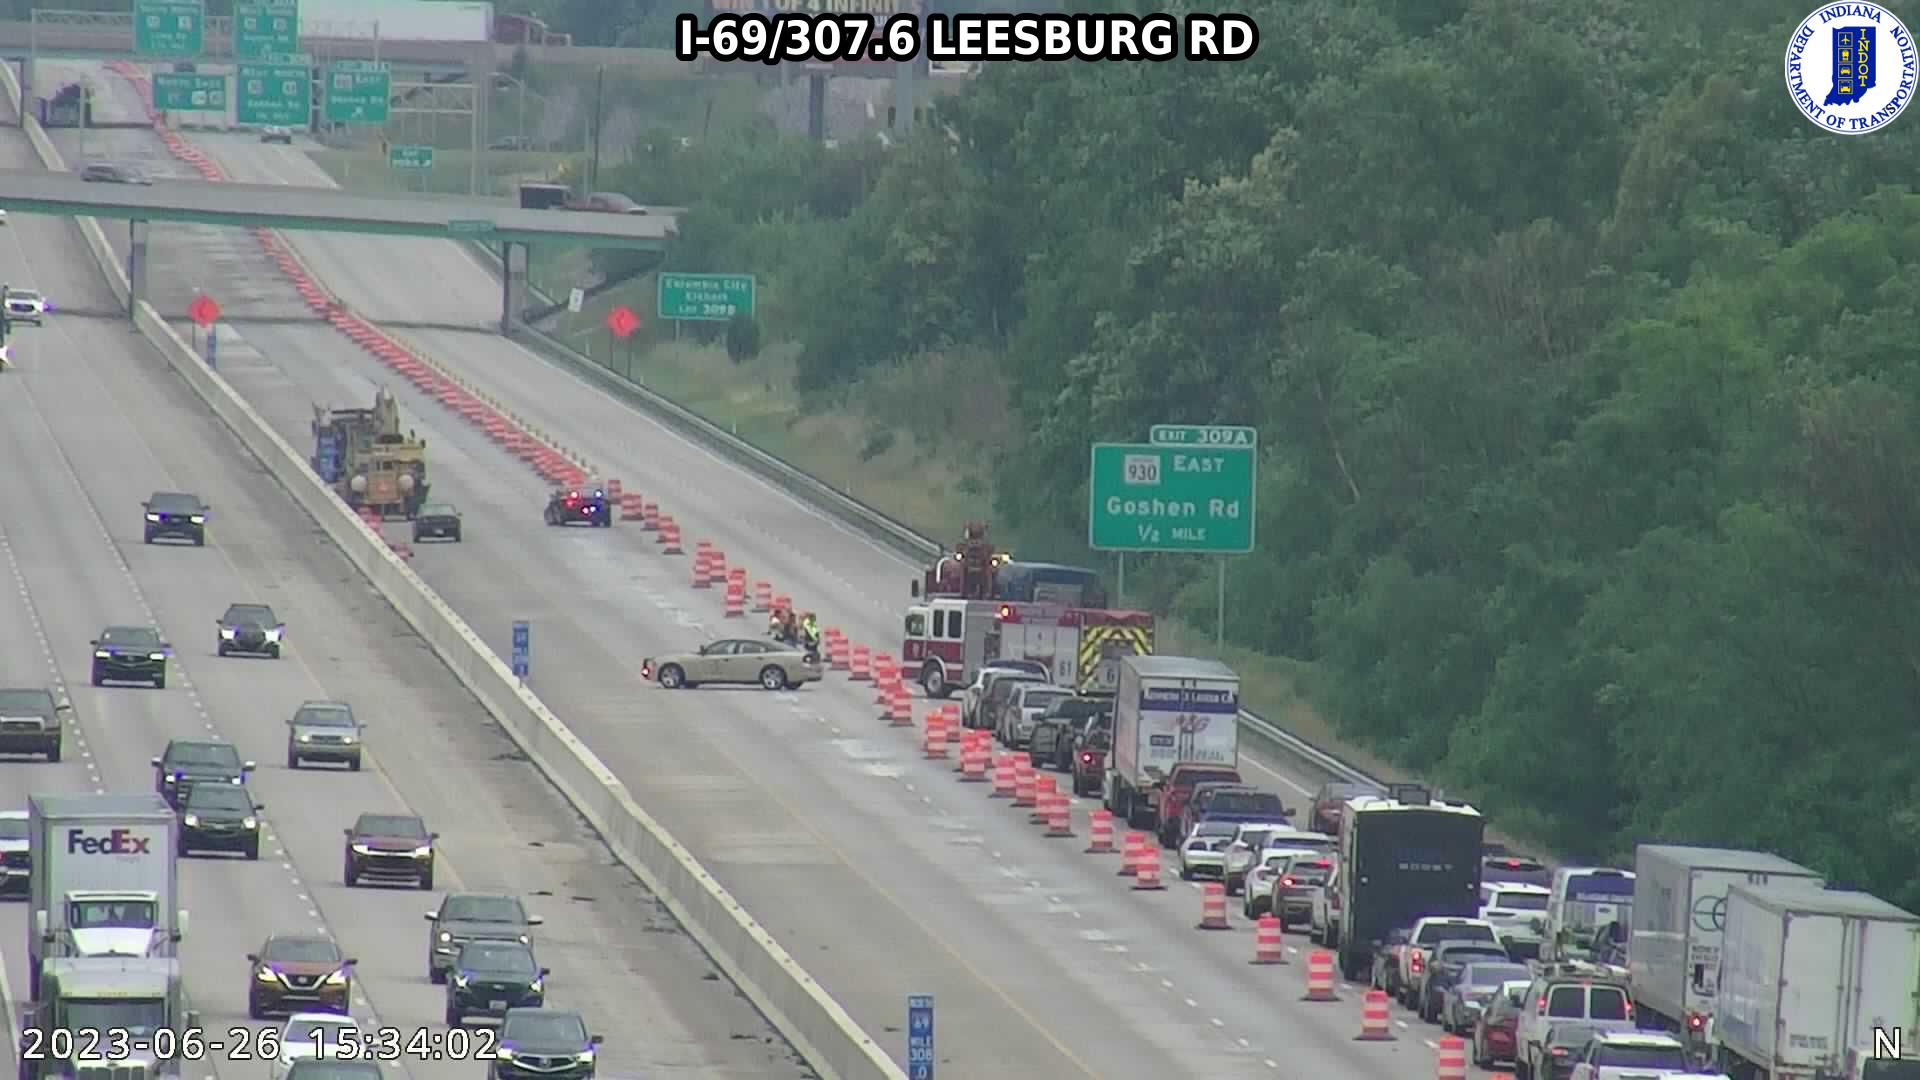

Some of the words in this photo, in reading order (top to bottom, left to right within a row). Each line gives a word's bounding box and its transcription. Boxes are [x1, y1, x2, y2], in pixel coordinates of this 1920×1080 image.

[1159, 430, 1186, 442] EXIT
[1197, 430, 1248, 444] 309A
[1128, 464, 1157, 481] 930
[1173, 455, 1225, 473] EAST
[1106, 496, 1196, 516] Goshen
[1208, 498, 1240, 519] Rd
[1171, 527, 1207, 541] MILE
[68, 829, 151, 854] FedEx
